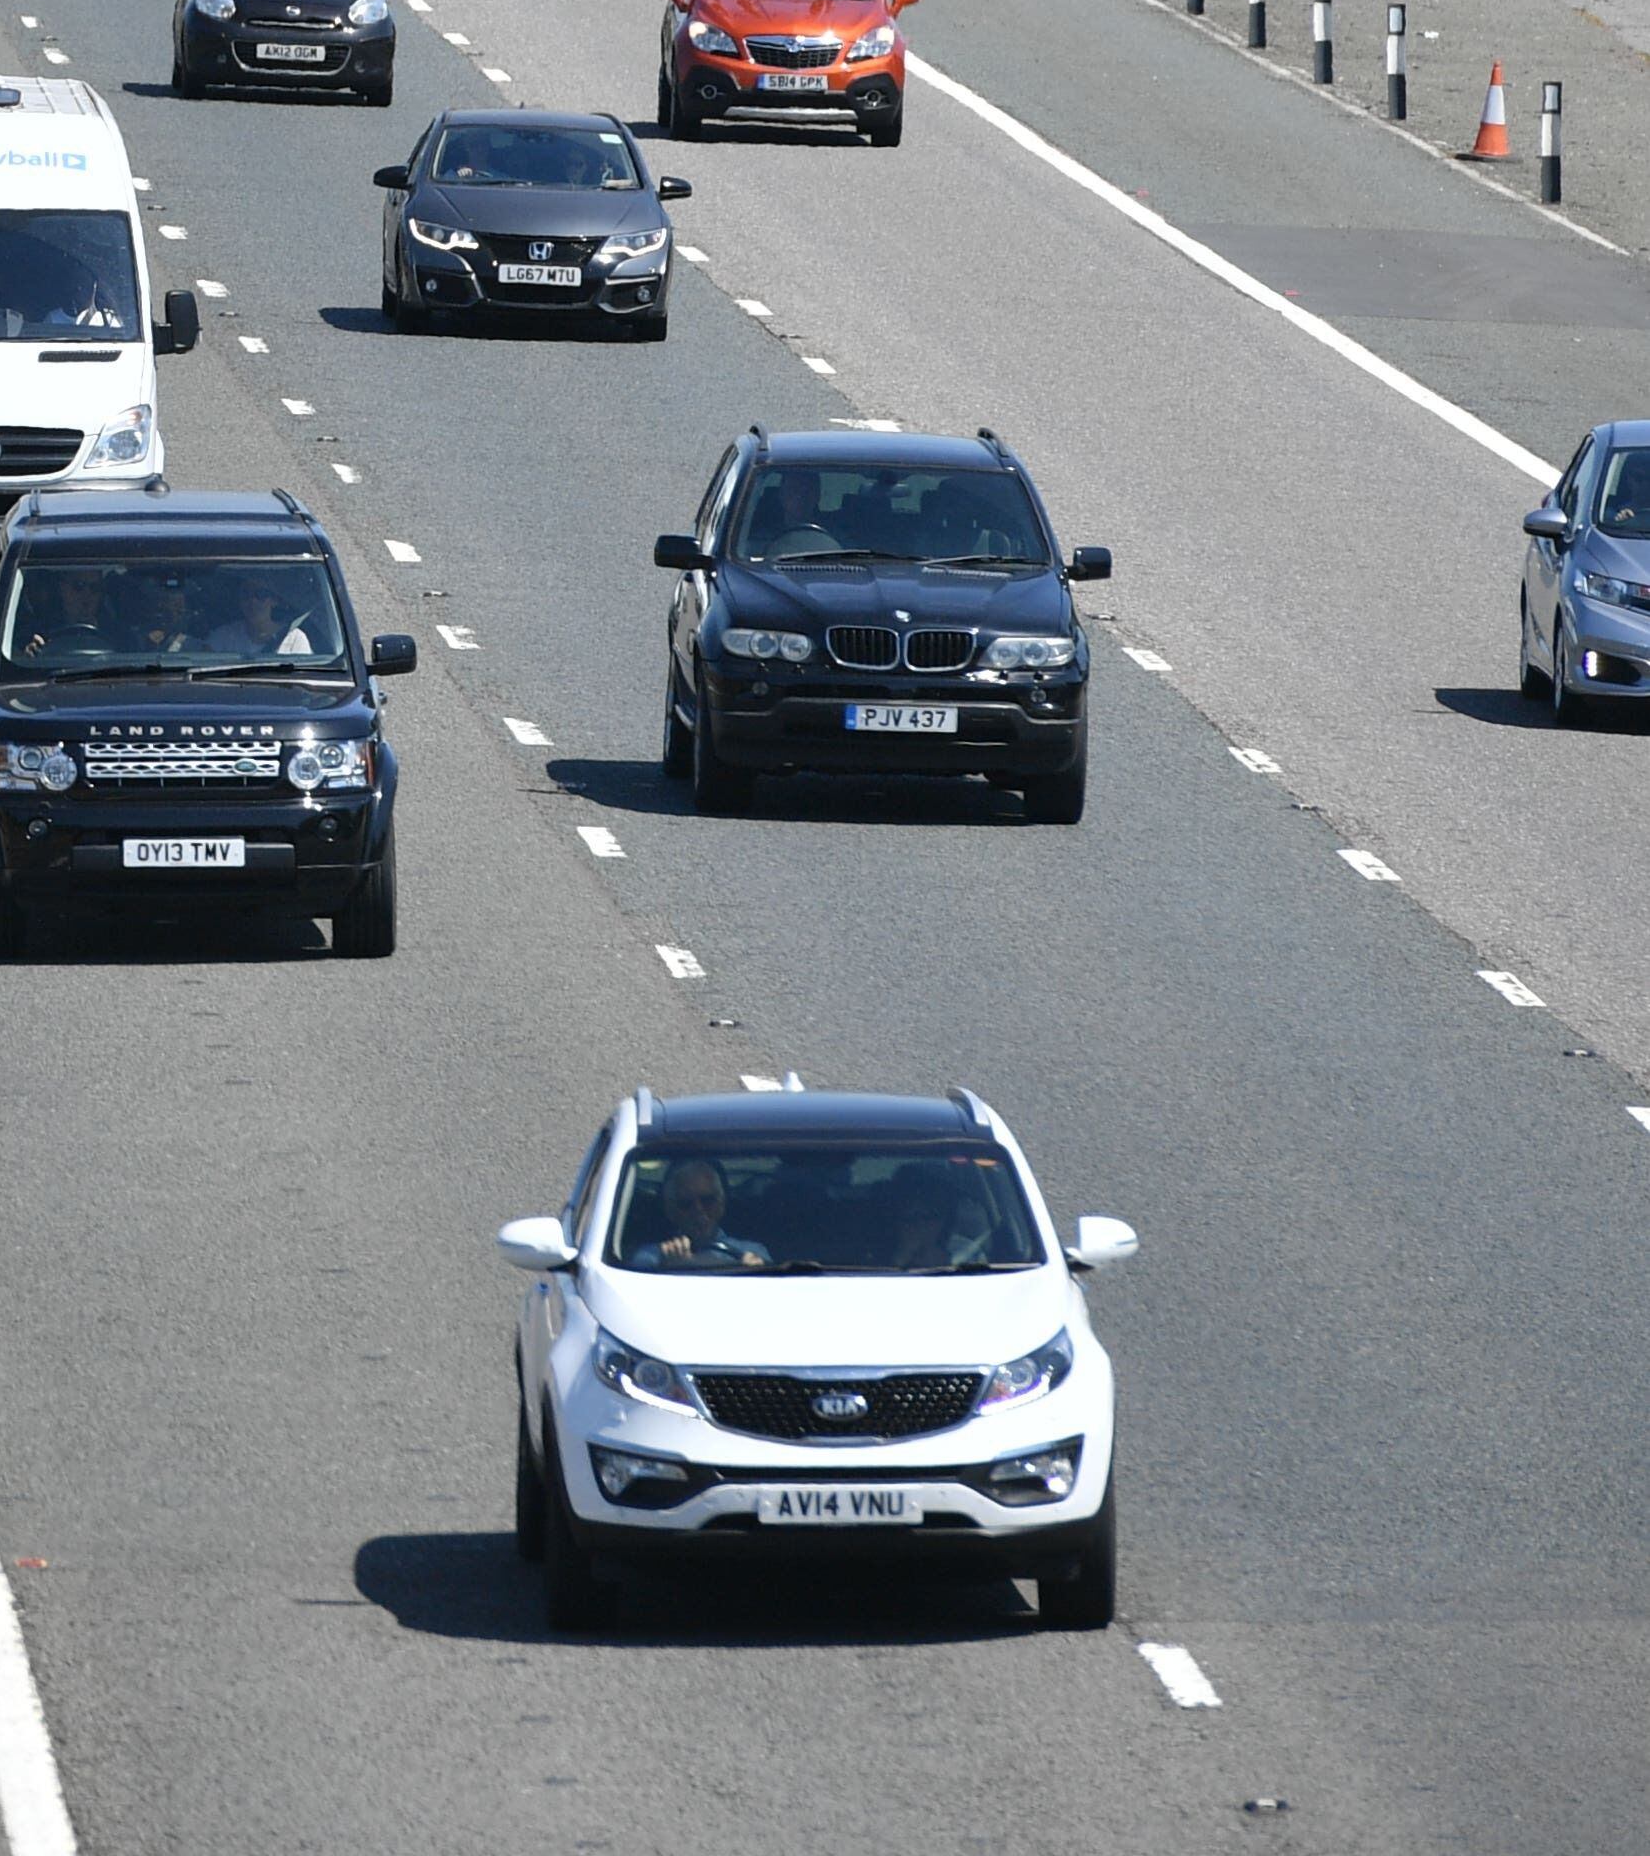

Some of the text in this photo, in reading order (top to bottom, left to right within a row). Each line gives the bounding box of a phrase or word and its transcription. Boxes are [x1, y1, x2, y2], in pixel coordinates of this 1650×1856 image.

[507, 267, 575, 284] LG67 MTU
[865, 708, 946, 728] PJV 437
[90, 725, 274, 736] LAND ROVER
[137, 843, 230, 862] OY13 TMV
[821, 1398, 859, 1415] KIA
[778, 1492, 905, 1515] AV14 VNU
